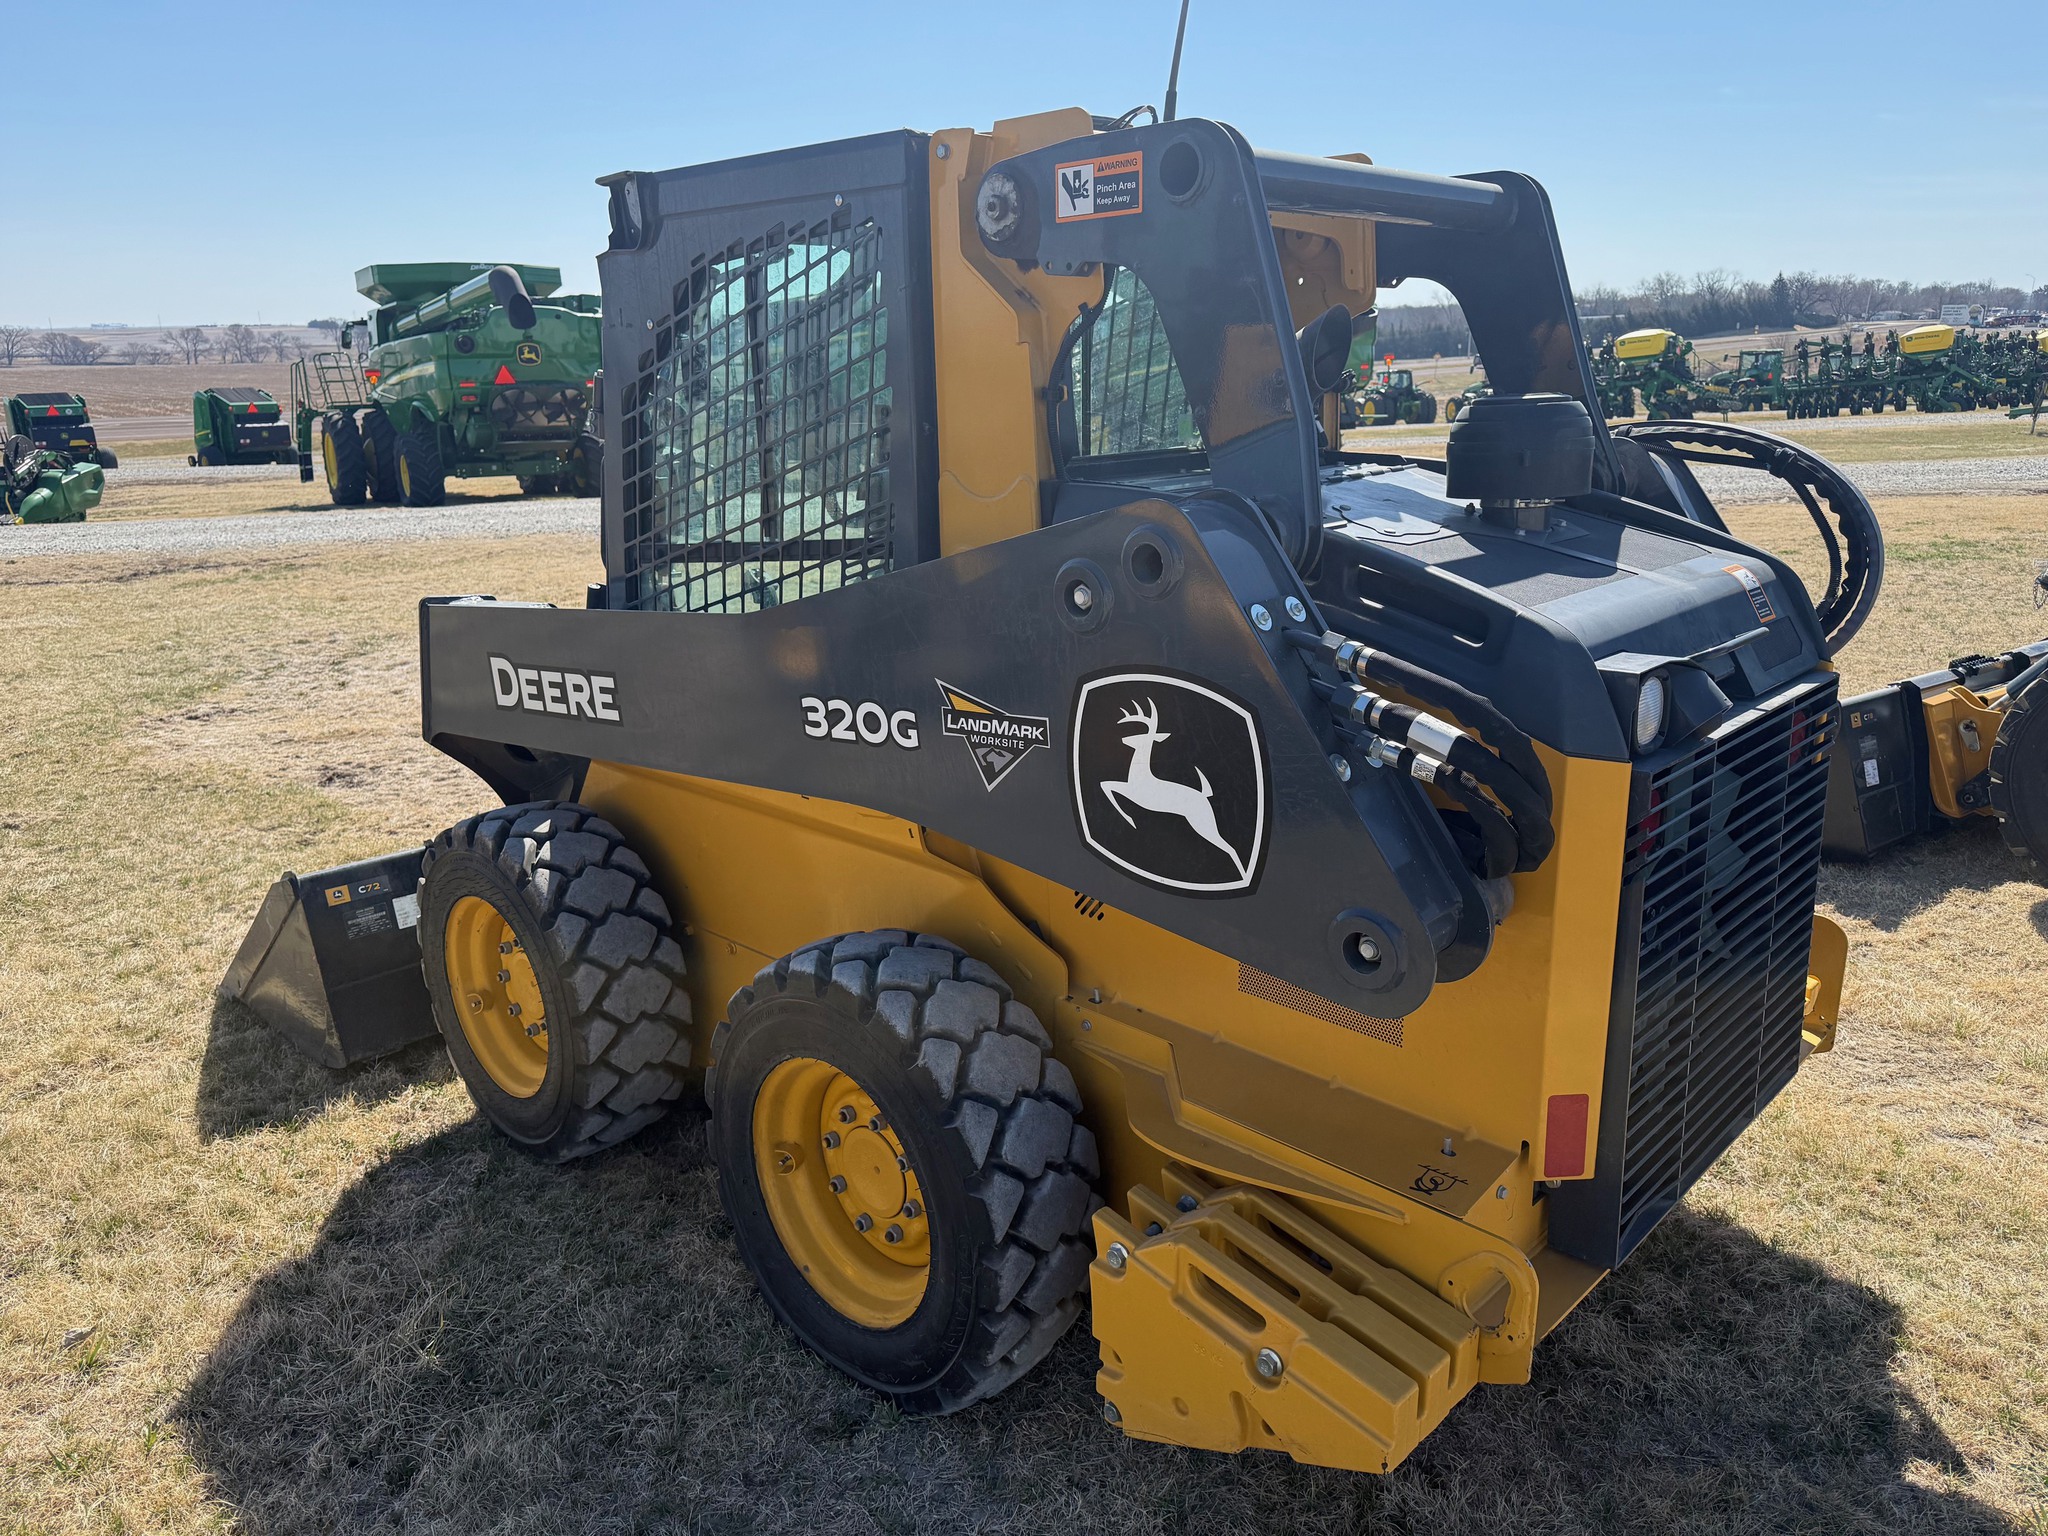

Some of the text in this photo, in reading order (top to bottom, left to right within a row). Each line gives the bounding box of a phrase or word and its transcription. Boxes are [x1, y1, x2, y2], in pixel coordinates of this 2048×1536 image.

[1104, 157, 1138, 171] WARNING
[1096, 181, 1136, 194] Pinch Area
[1096, 194, 1131, 205] Keep Away
[489, 656, 620, 721] DEERE
[801, 696, 920, 748] 320G
[946, 713, 1045, 741] LANDMARK
[970, 734, 1025, 750] WORKSITE
[358, 882, 381, 894] C72
